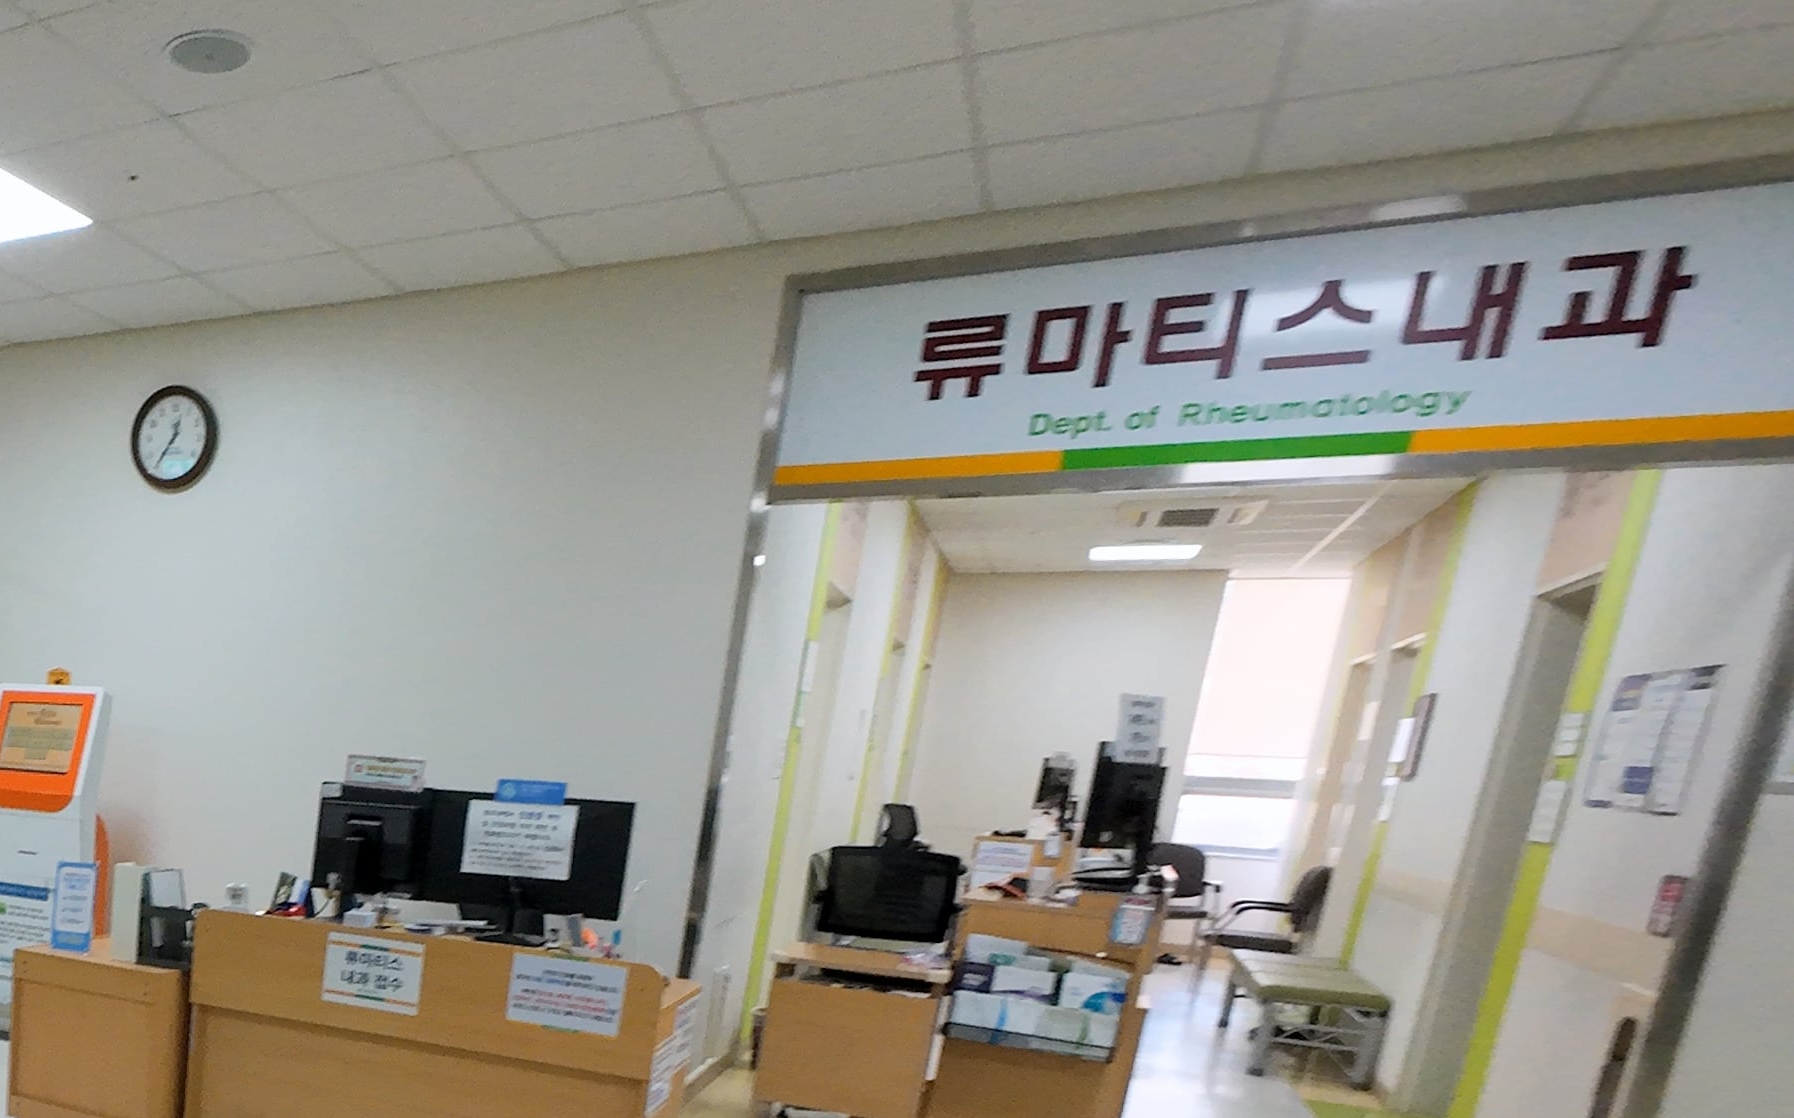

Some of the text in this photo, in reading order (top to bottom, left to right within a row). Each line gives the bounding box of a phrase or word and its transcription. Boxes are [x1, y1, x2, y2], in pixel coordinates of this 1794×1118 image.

[913, 245, 1698, 400] 류마티스내과
[1028, 388, 1473, 439] Dept. of Rheumatology
